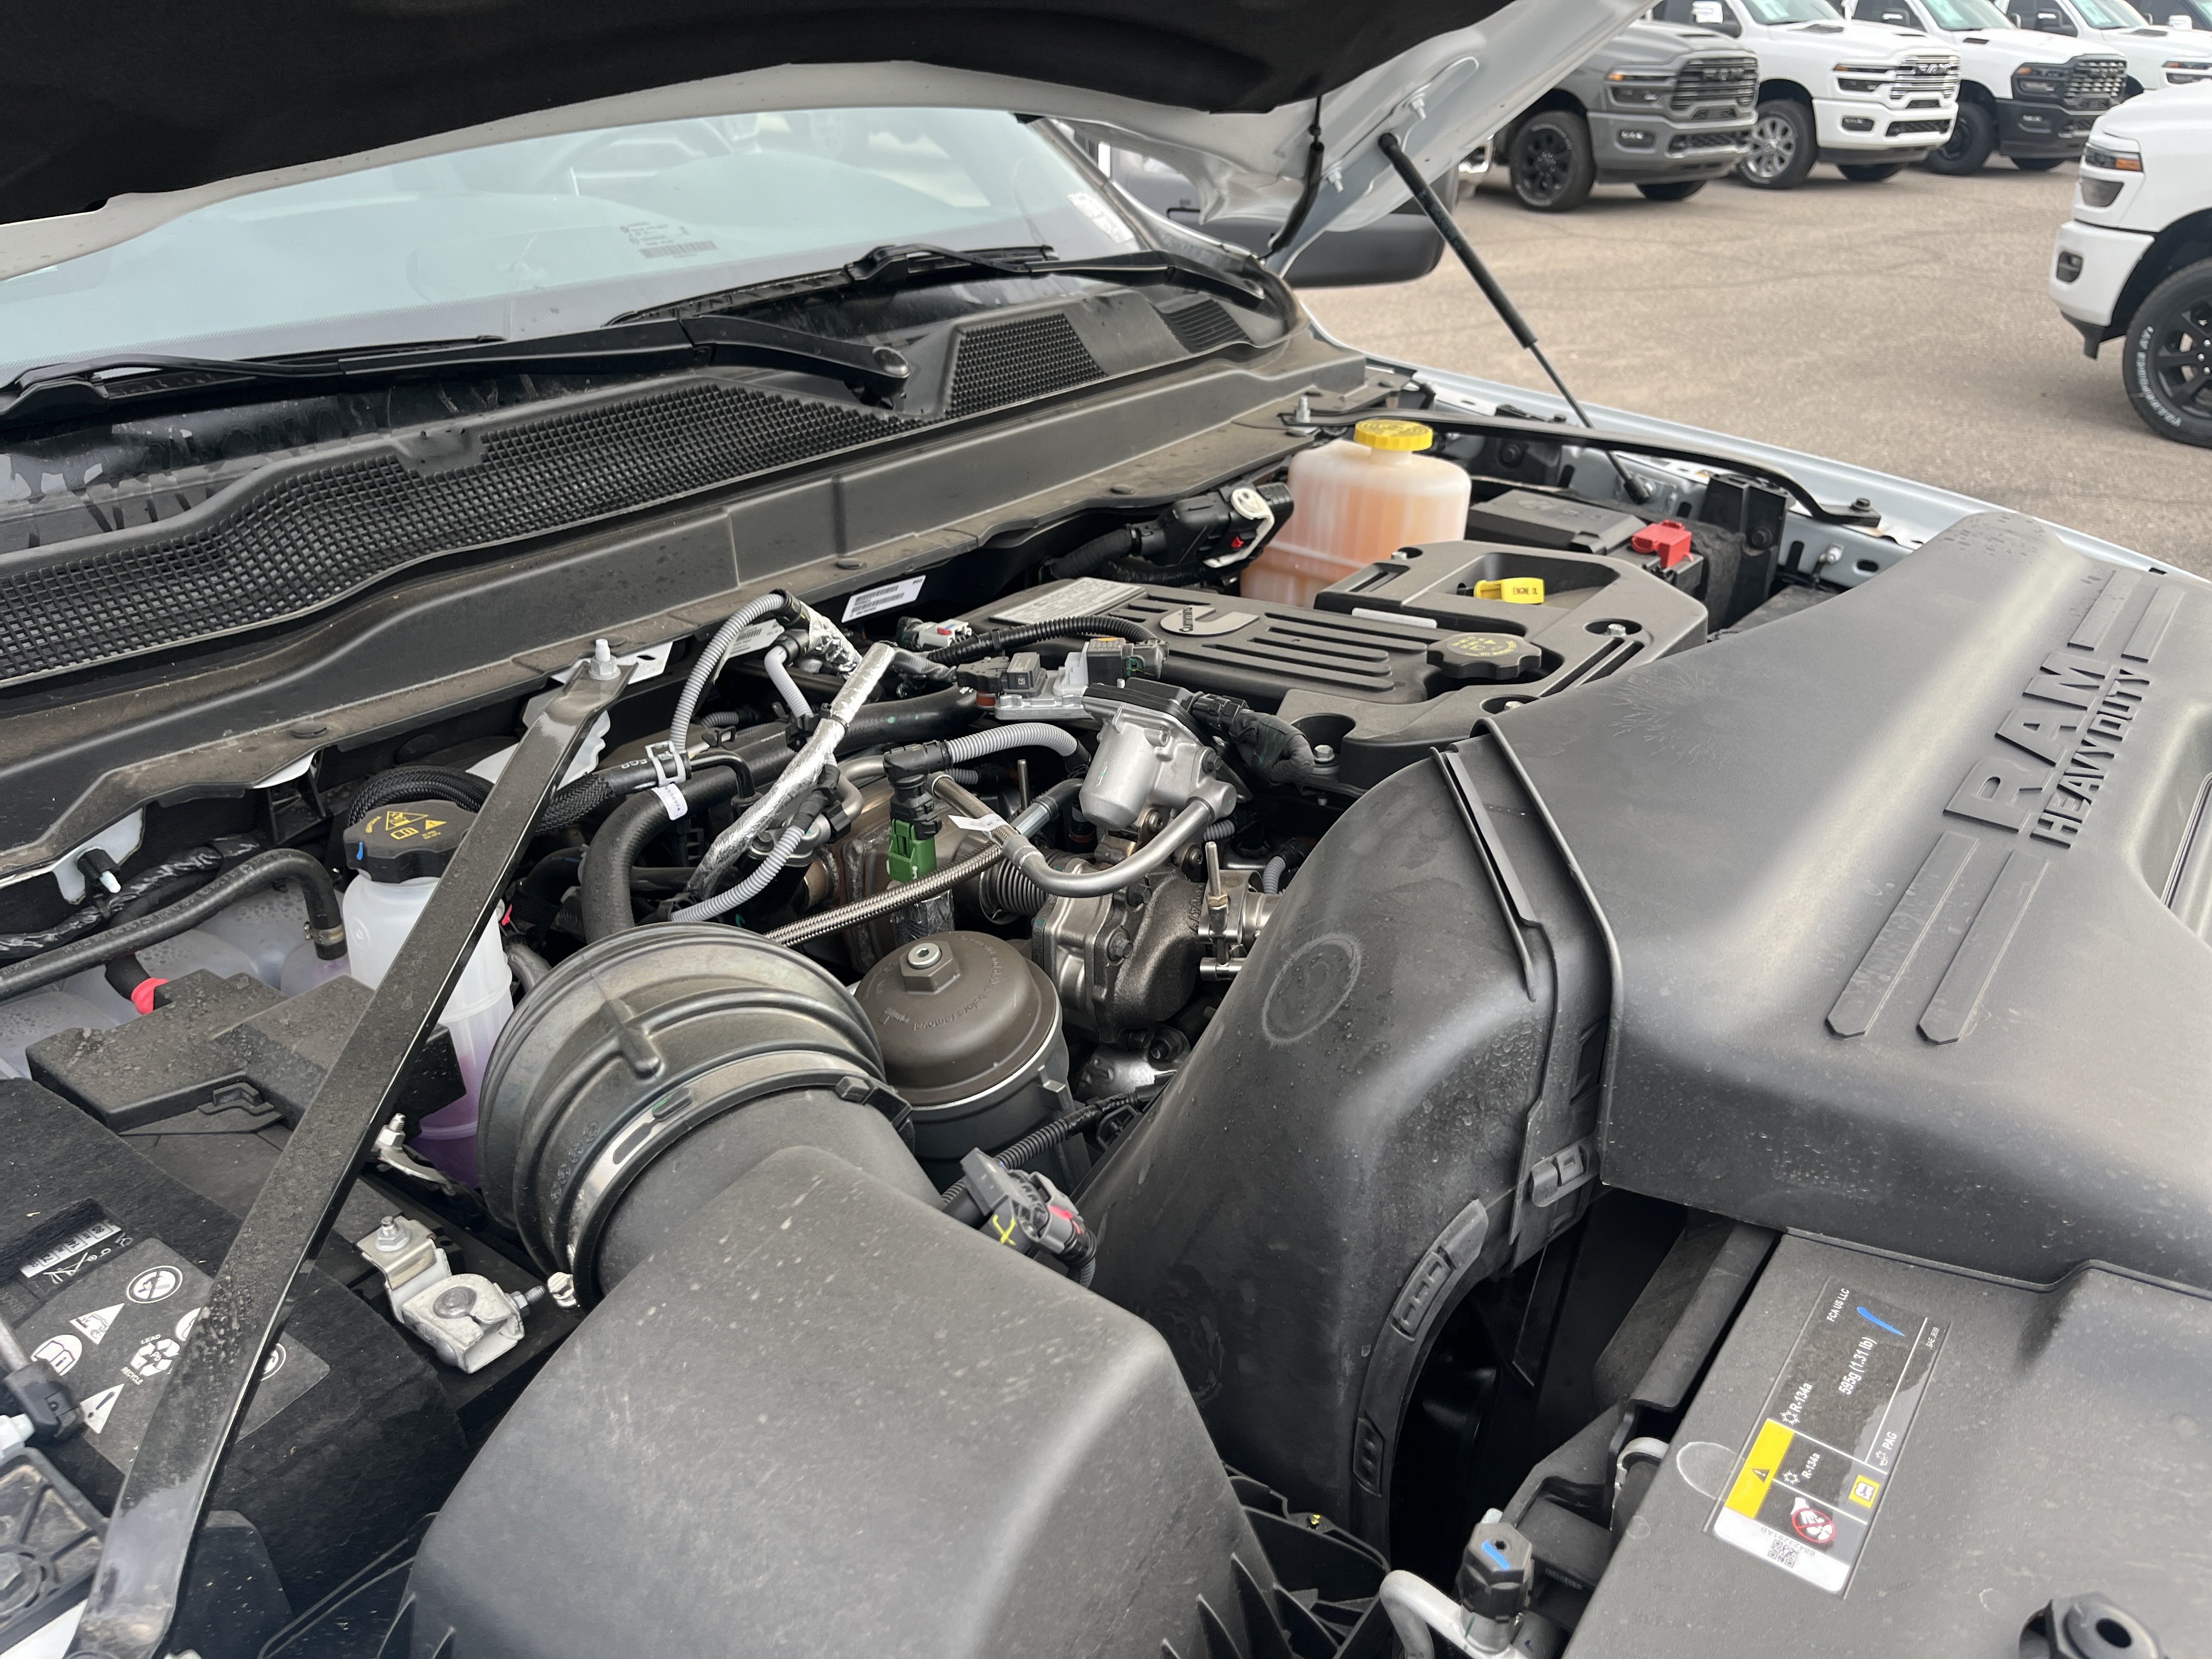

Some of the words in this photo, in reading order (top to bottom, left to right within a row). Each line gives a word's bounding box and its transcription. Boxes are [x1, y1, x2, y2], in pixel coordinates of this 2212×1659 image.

[1943, 650, 2111, 833] RAM
[2030, 738, 2116, 849] HEAVY
[2087, 668, 2151, 741] DUTY
[913, 1015, 956, 1031] removal
[1838, 1288, 1850, 1301] LLC
[1833, 1299, 1844, 1310] US
[1826, 1307, 1839, 1322] FCA
[140, 1334, 162, 1345] LEAD
[1858, 1336, 1878, 1351] lb)
[1848, 1348, 1869, 1373] (1.31
[121, 1366, 144, 1385] RECYCLE
[1838, 1372, 1862, 1395] 595g
[1790, 1381, 1813, 1413] R-134a
[1883, 1431, 1898, 1451] PAG
[1802, 1452, 1821, 1480] R-134a
